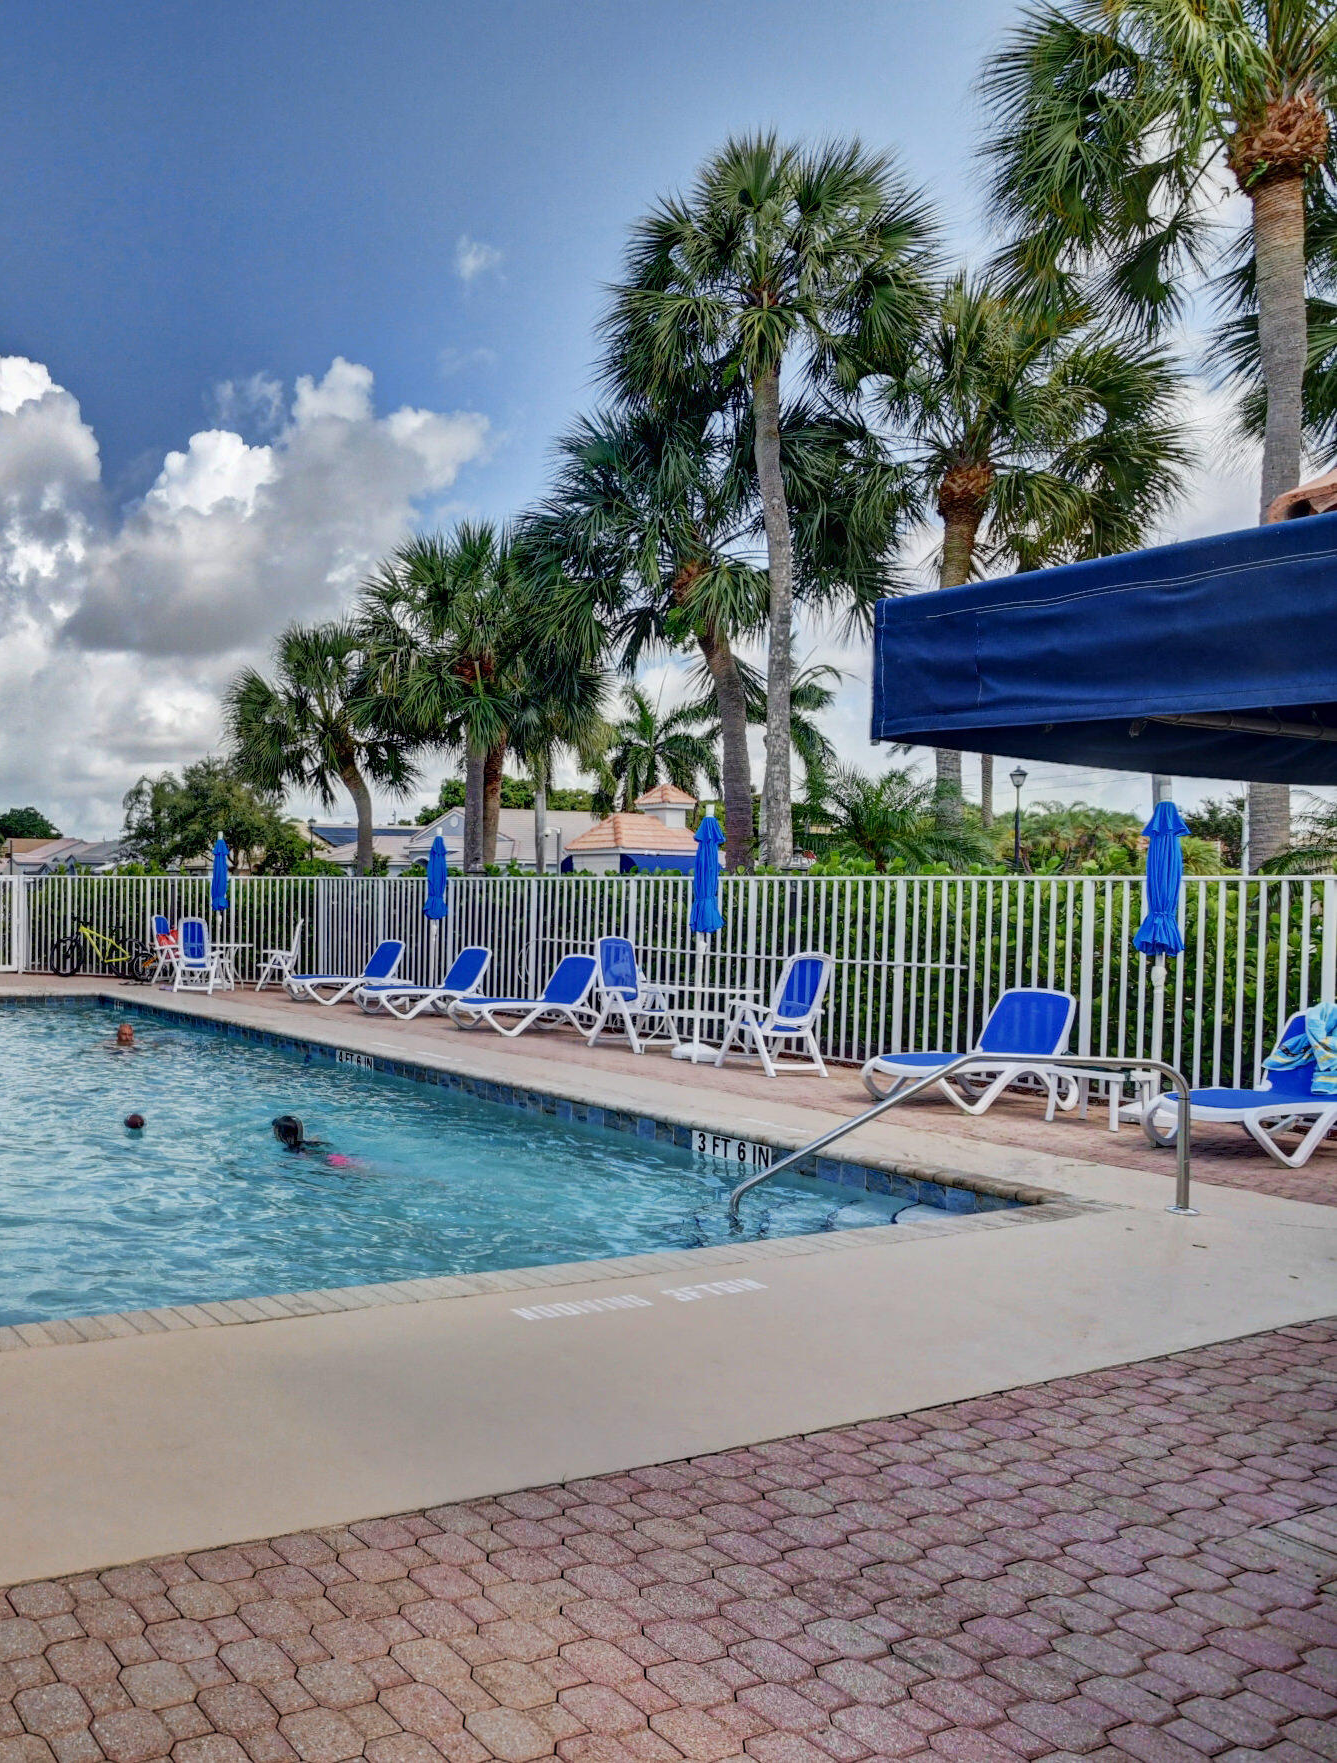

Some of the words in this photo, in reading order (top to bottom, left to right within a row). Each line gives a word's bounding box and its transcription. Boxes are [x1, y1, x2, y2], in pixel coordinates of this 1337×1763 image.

[345, 1052, 354, 1064] FT
[364, 1057, 373, 1069] IN
[698, 1132, 706, 1152] 3
[712, 1136, 731, 1158] FT
[737, 1141, 746, 1162] 6
[752, 1145, 769, 1168] IN
